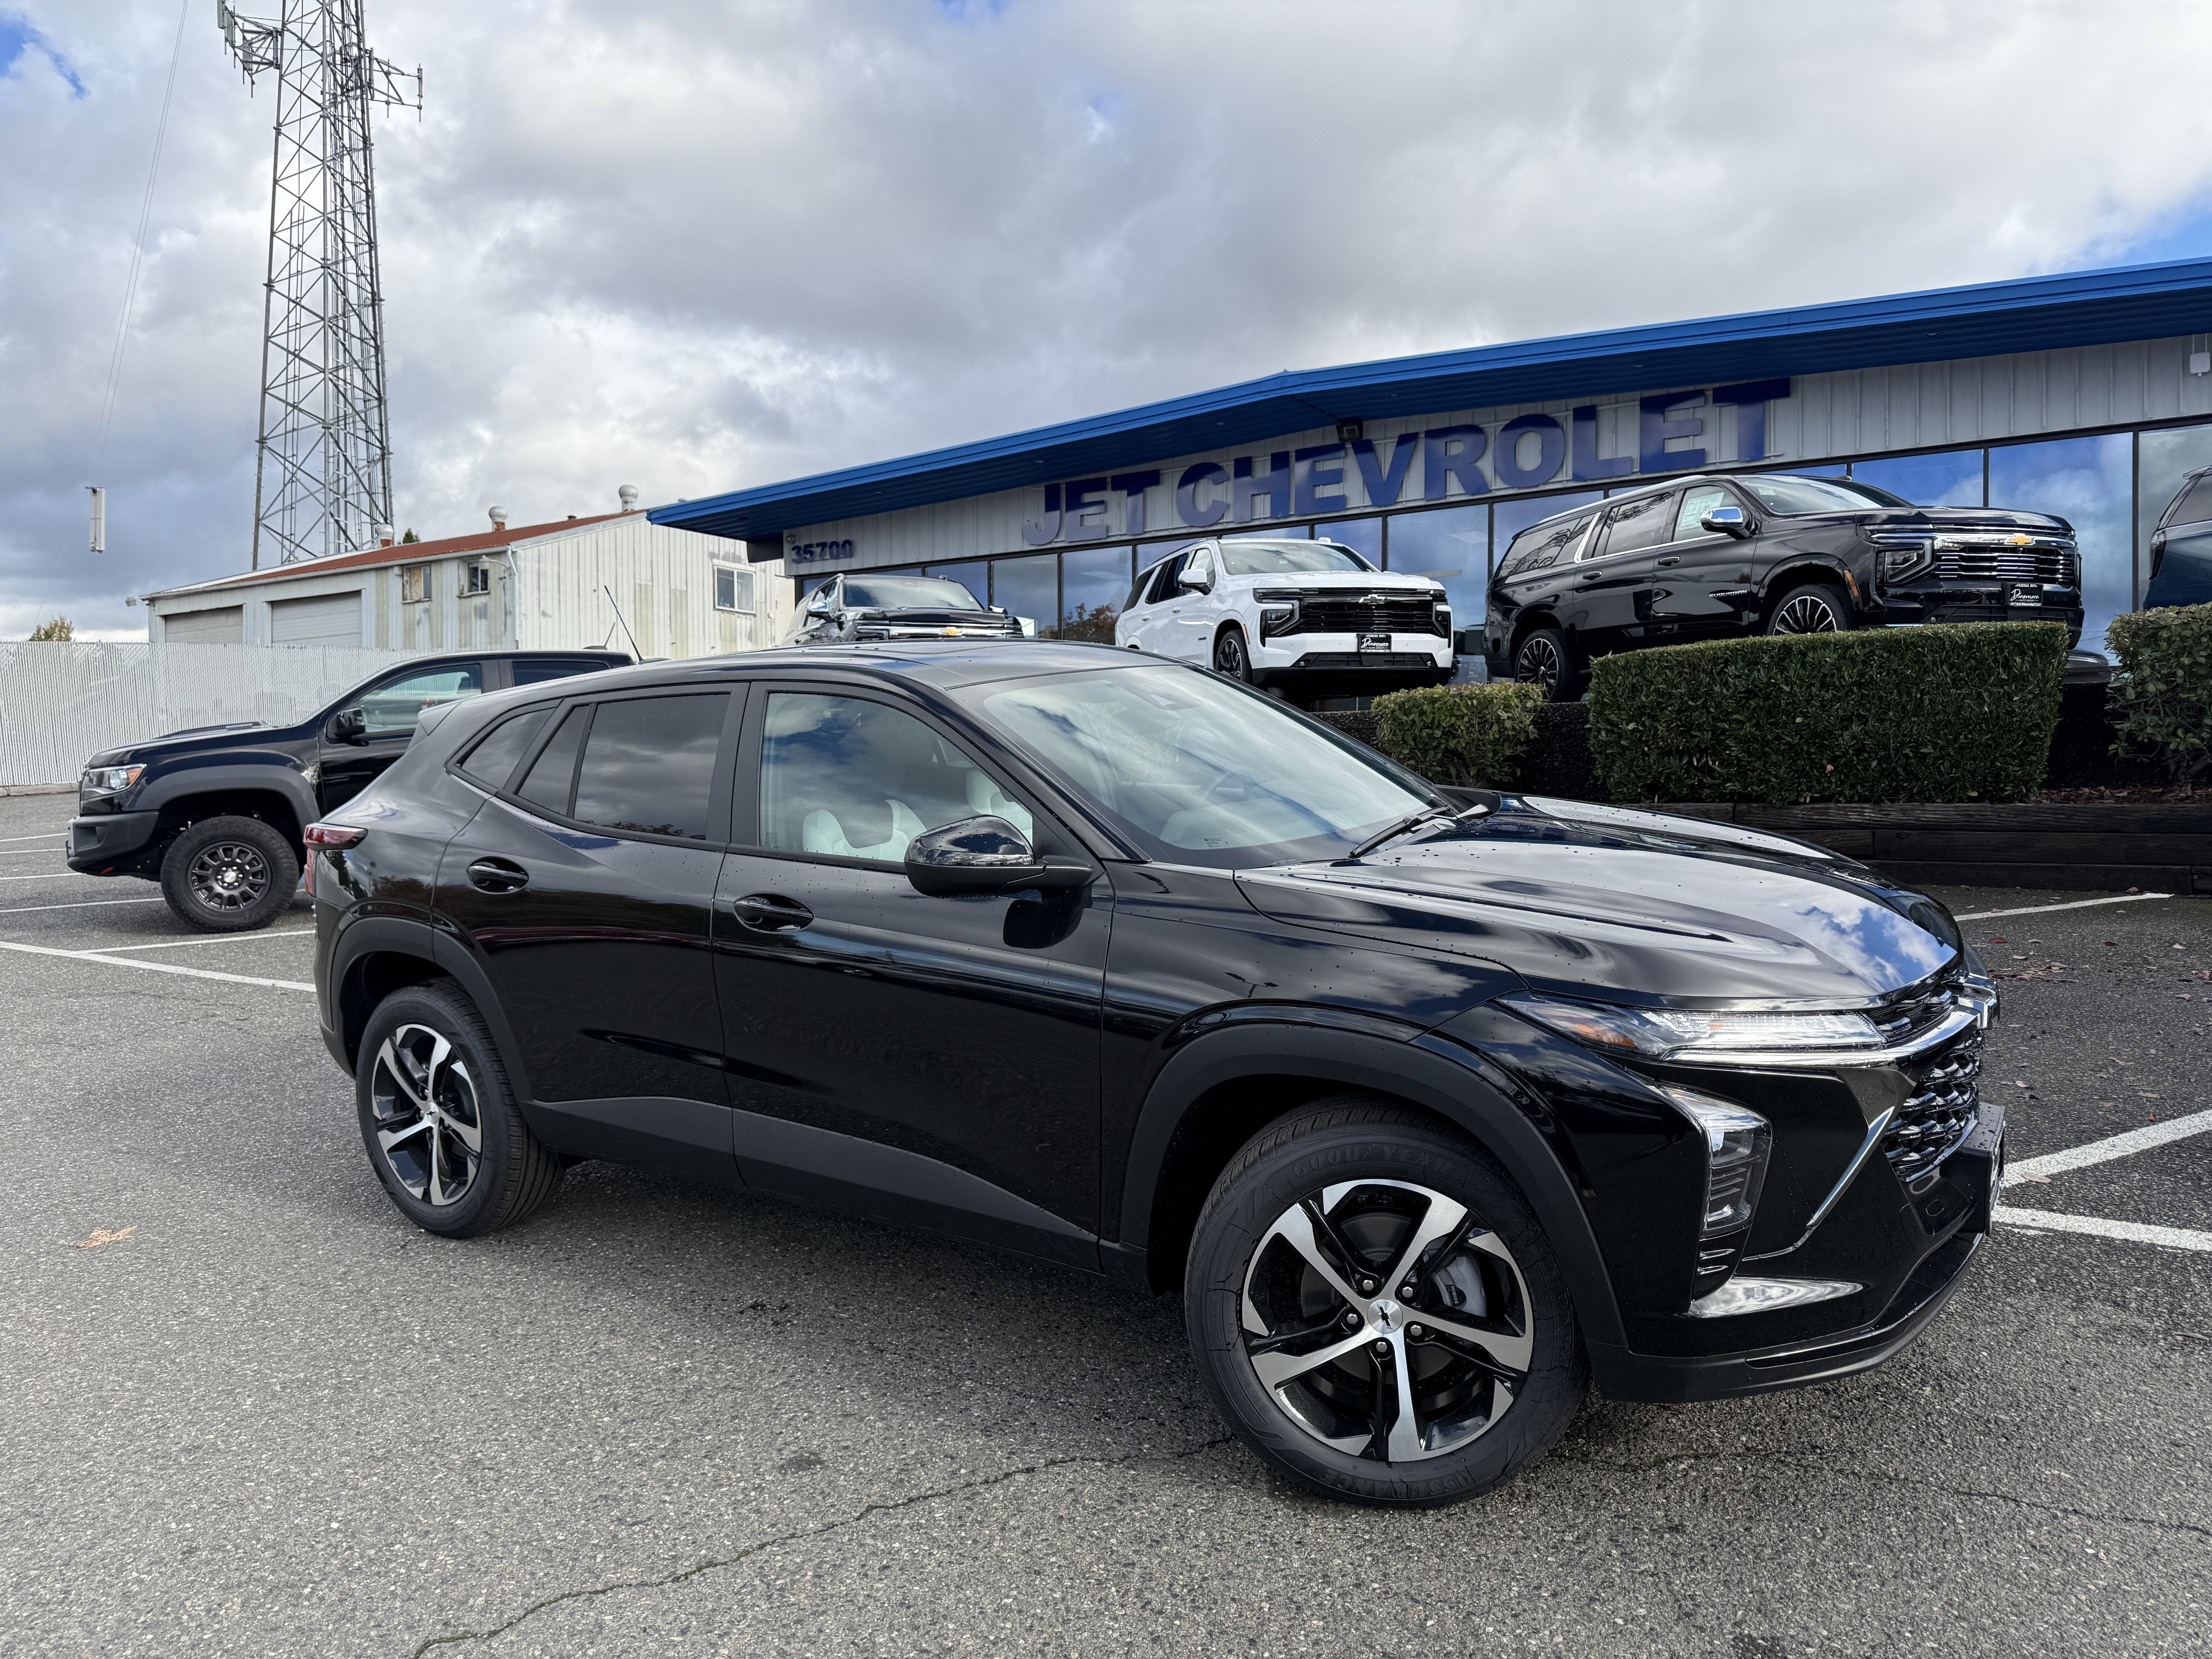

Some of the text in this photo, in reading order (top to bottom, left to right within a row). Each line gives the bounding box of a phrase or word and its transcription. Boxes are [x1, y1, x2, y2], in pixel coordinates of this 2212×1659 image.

[1022, 377, 1790, 546] JET CHEVROLET
[792, 539, 854, 564] 35700
[1320, 1469, 1477, 1498] ASSURANCE
